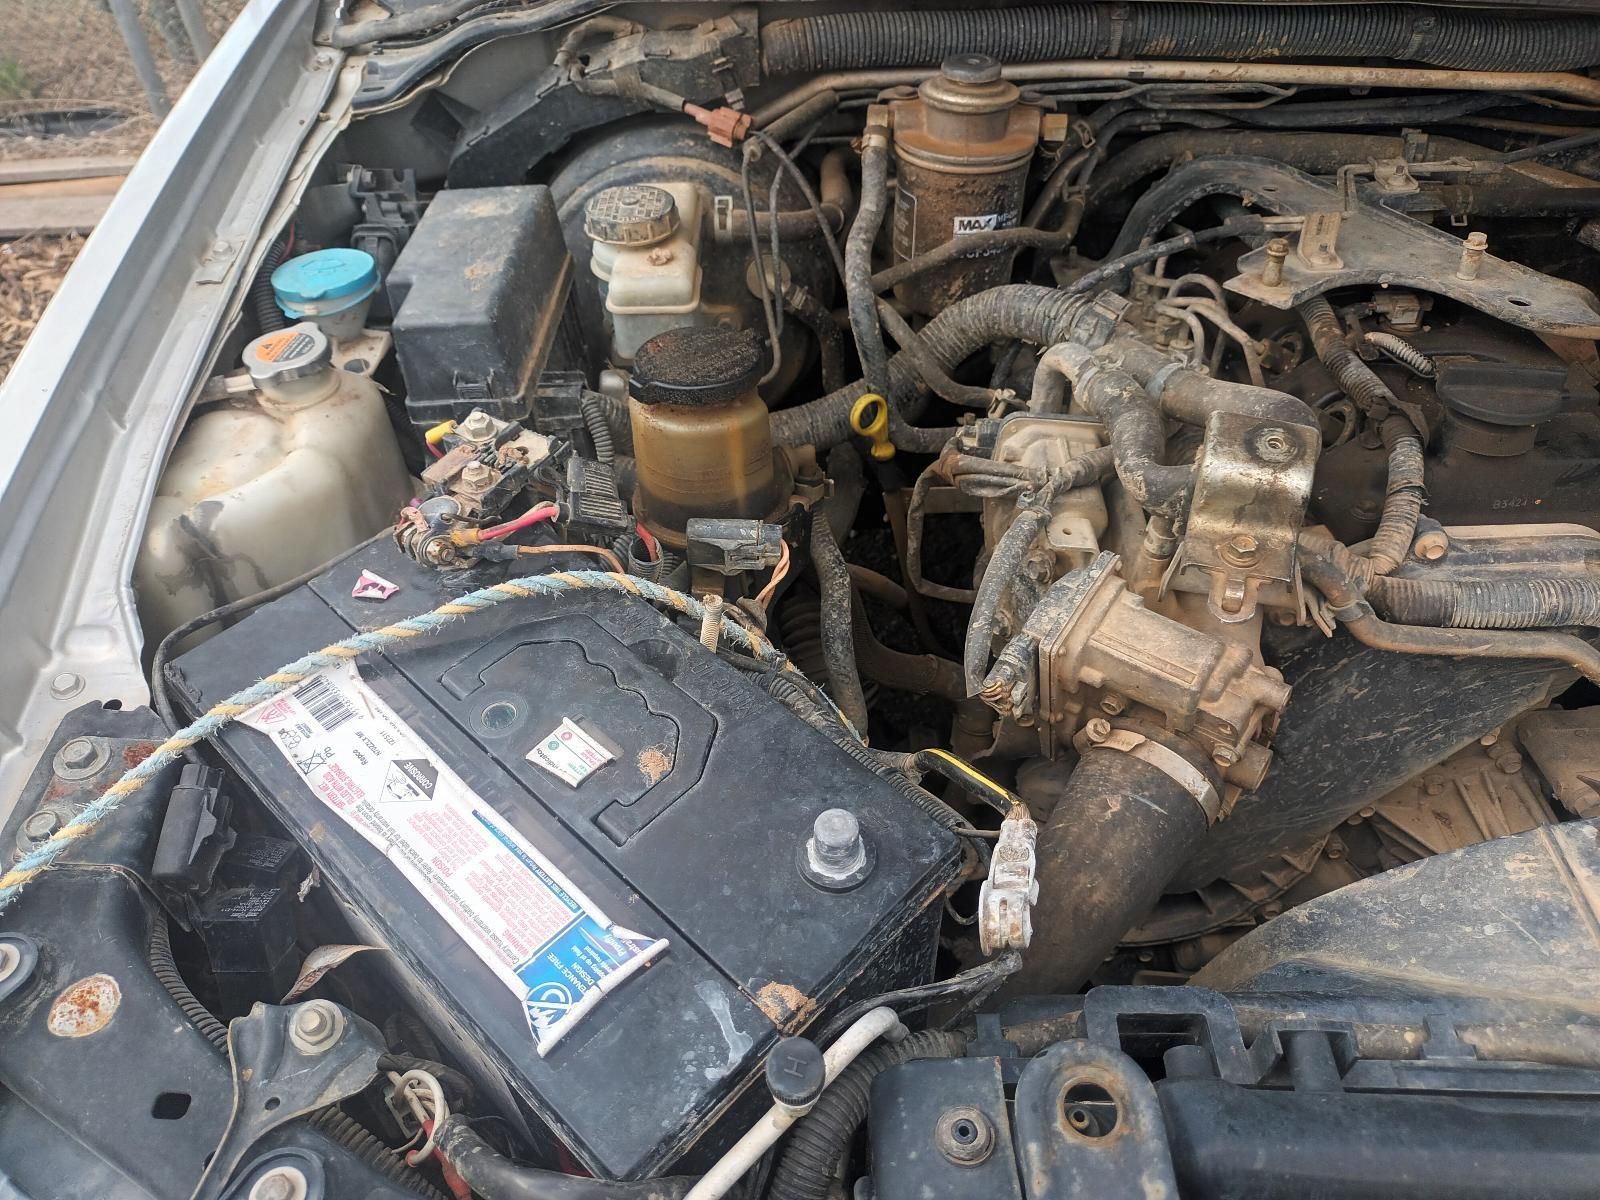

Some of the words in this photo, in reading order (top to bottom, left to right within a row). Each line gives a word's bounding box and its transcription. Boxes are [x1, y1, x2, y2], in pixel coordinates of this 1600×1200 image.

[321, 746, 335, 757] Pb
[352, 749, 368, 764] Repco
[403, 761, 432, 788] CORROSIVE
[430, 856, 453, 876] POISON
[501, 930, 530, 956] WARNING
[545, 953, 564, 969] FREE
[570, 962, 595, 984] DESIGN
